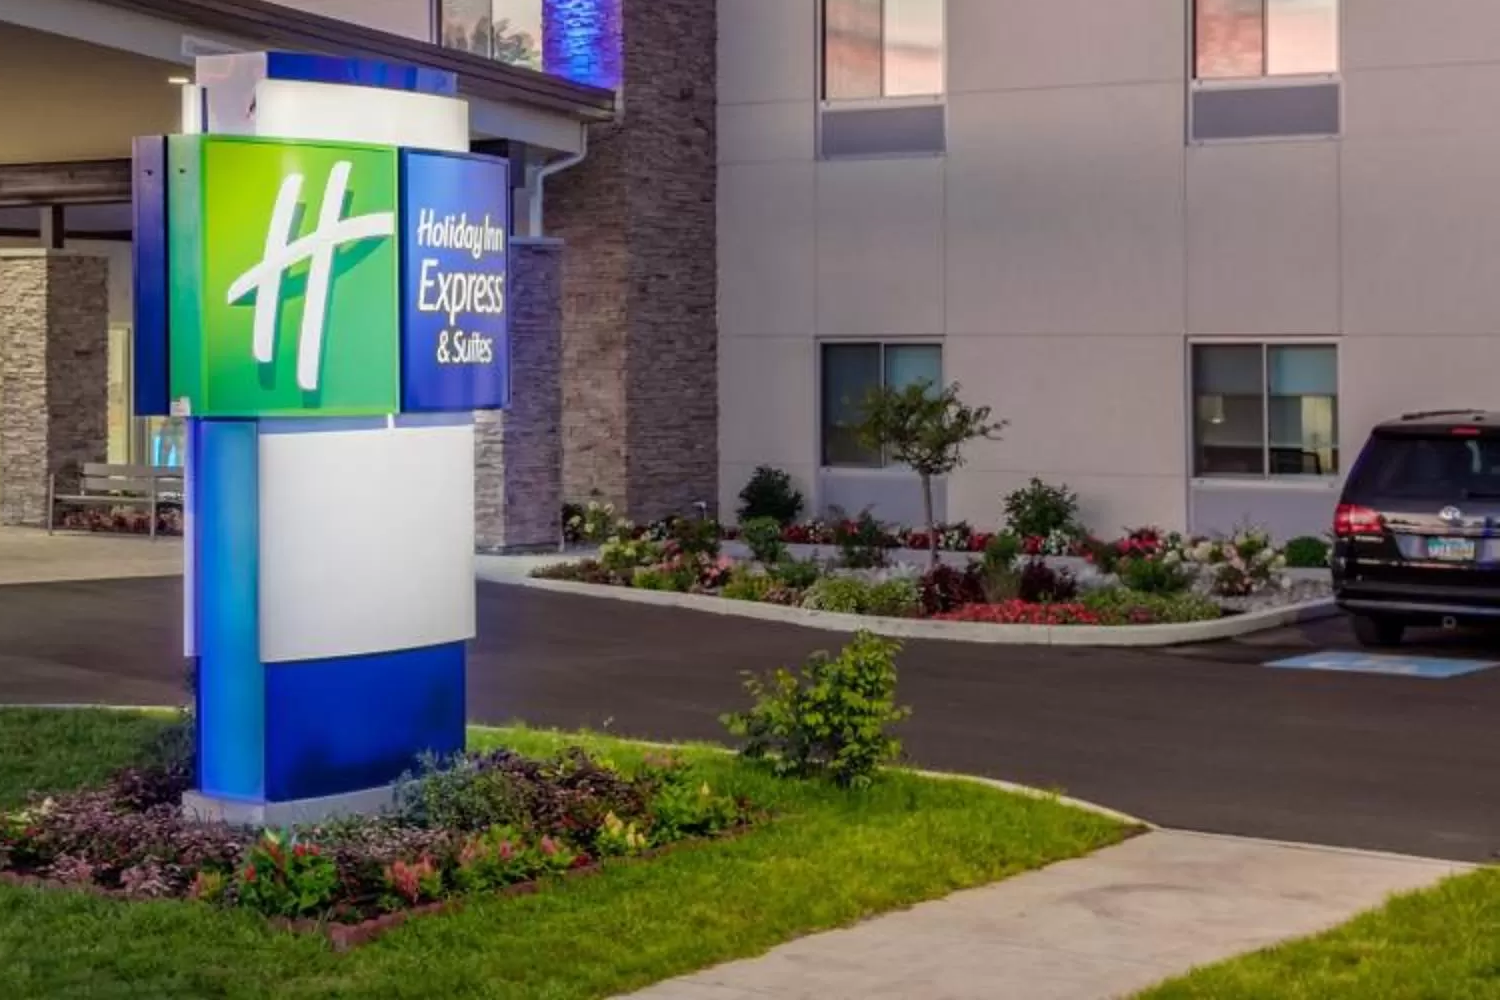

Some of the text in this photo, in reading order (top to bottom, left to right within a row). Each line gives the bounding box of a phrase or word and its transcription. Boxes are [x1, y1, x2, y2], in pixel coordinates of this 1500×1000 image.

[417, 208, 504, 260] Holiday Inn
[227, 160, 395, 391] H
[418, 258, 504, 327] Express
[437, 329, 493, 364] & Suites
